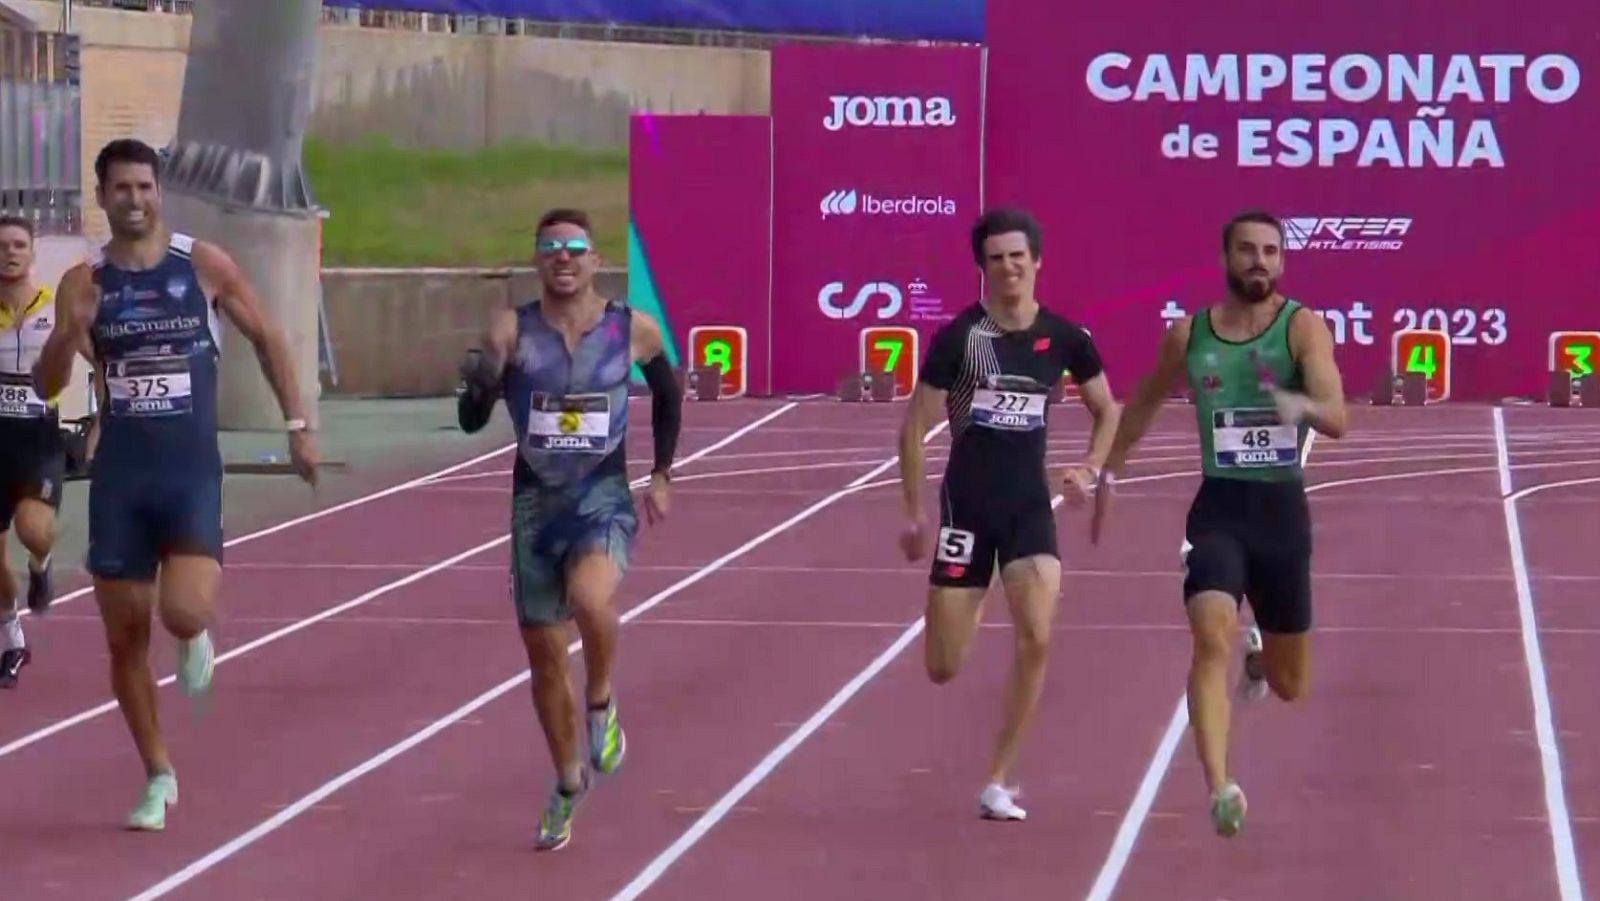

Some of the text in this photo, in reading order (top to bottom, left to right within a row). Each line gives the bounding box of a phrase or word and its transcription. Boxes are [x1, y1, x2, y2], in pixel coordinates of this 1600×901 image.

[1085, 52, 1581, 104] CAMPEONATO
[1161, 106, 1505, 167] de ESPAÑA
[862, 195, 956, 215] Iberdrola
[1314, 218, 1412, 239] RFEA
[1307, 240, 1403, 250] ATLETISMO
[874, 341, 903, 373] 7
[1406, 345, 1436, 380] 4
[1565, 346, 1593, 379] 3
[127, 377, 169, 397] 375
[993, 394, 1029, 412] 227
[1242, 429, 1271, 447] 48
[945, 531, 967, 558] 5
